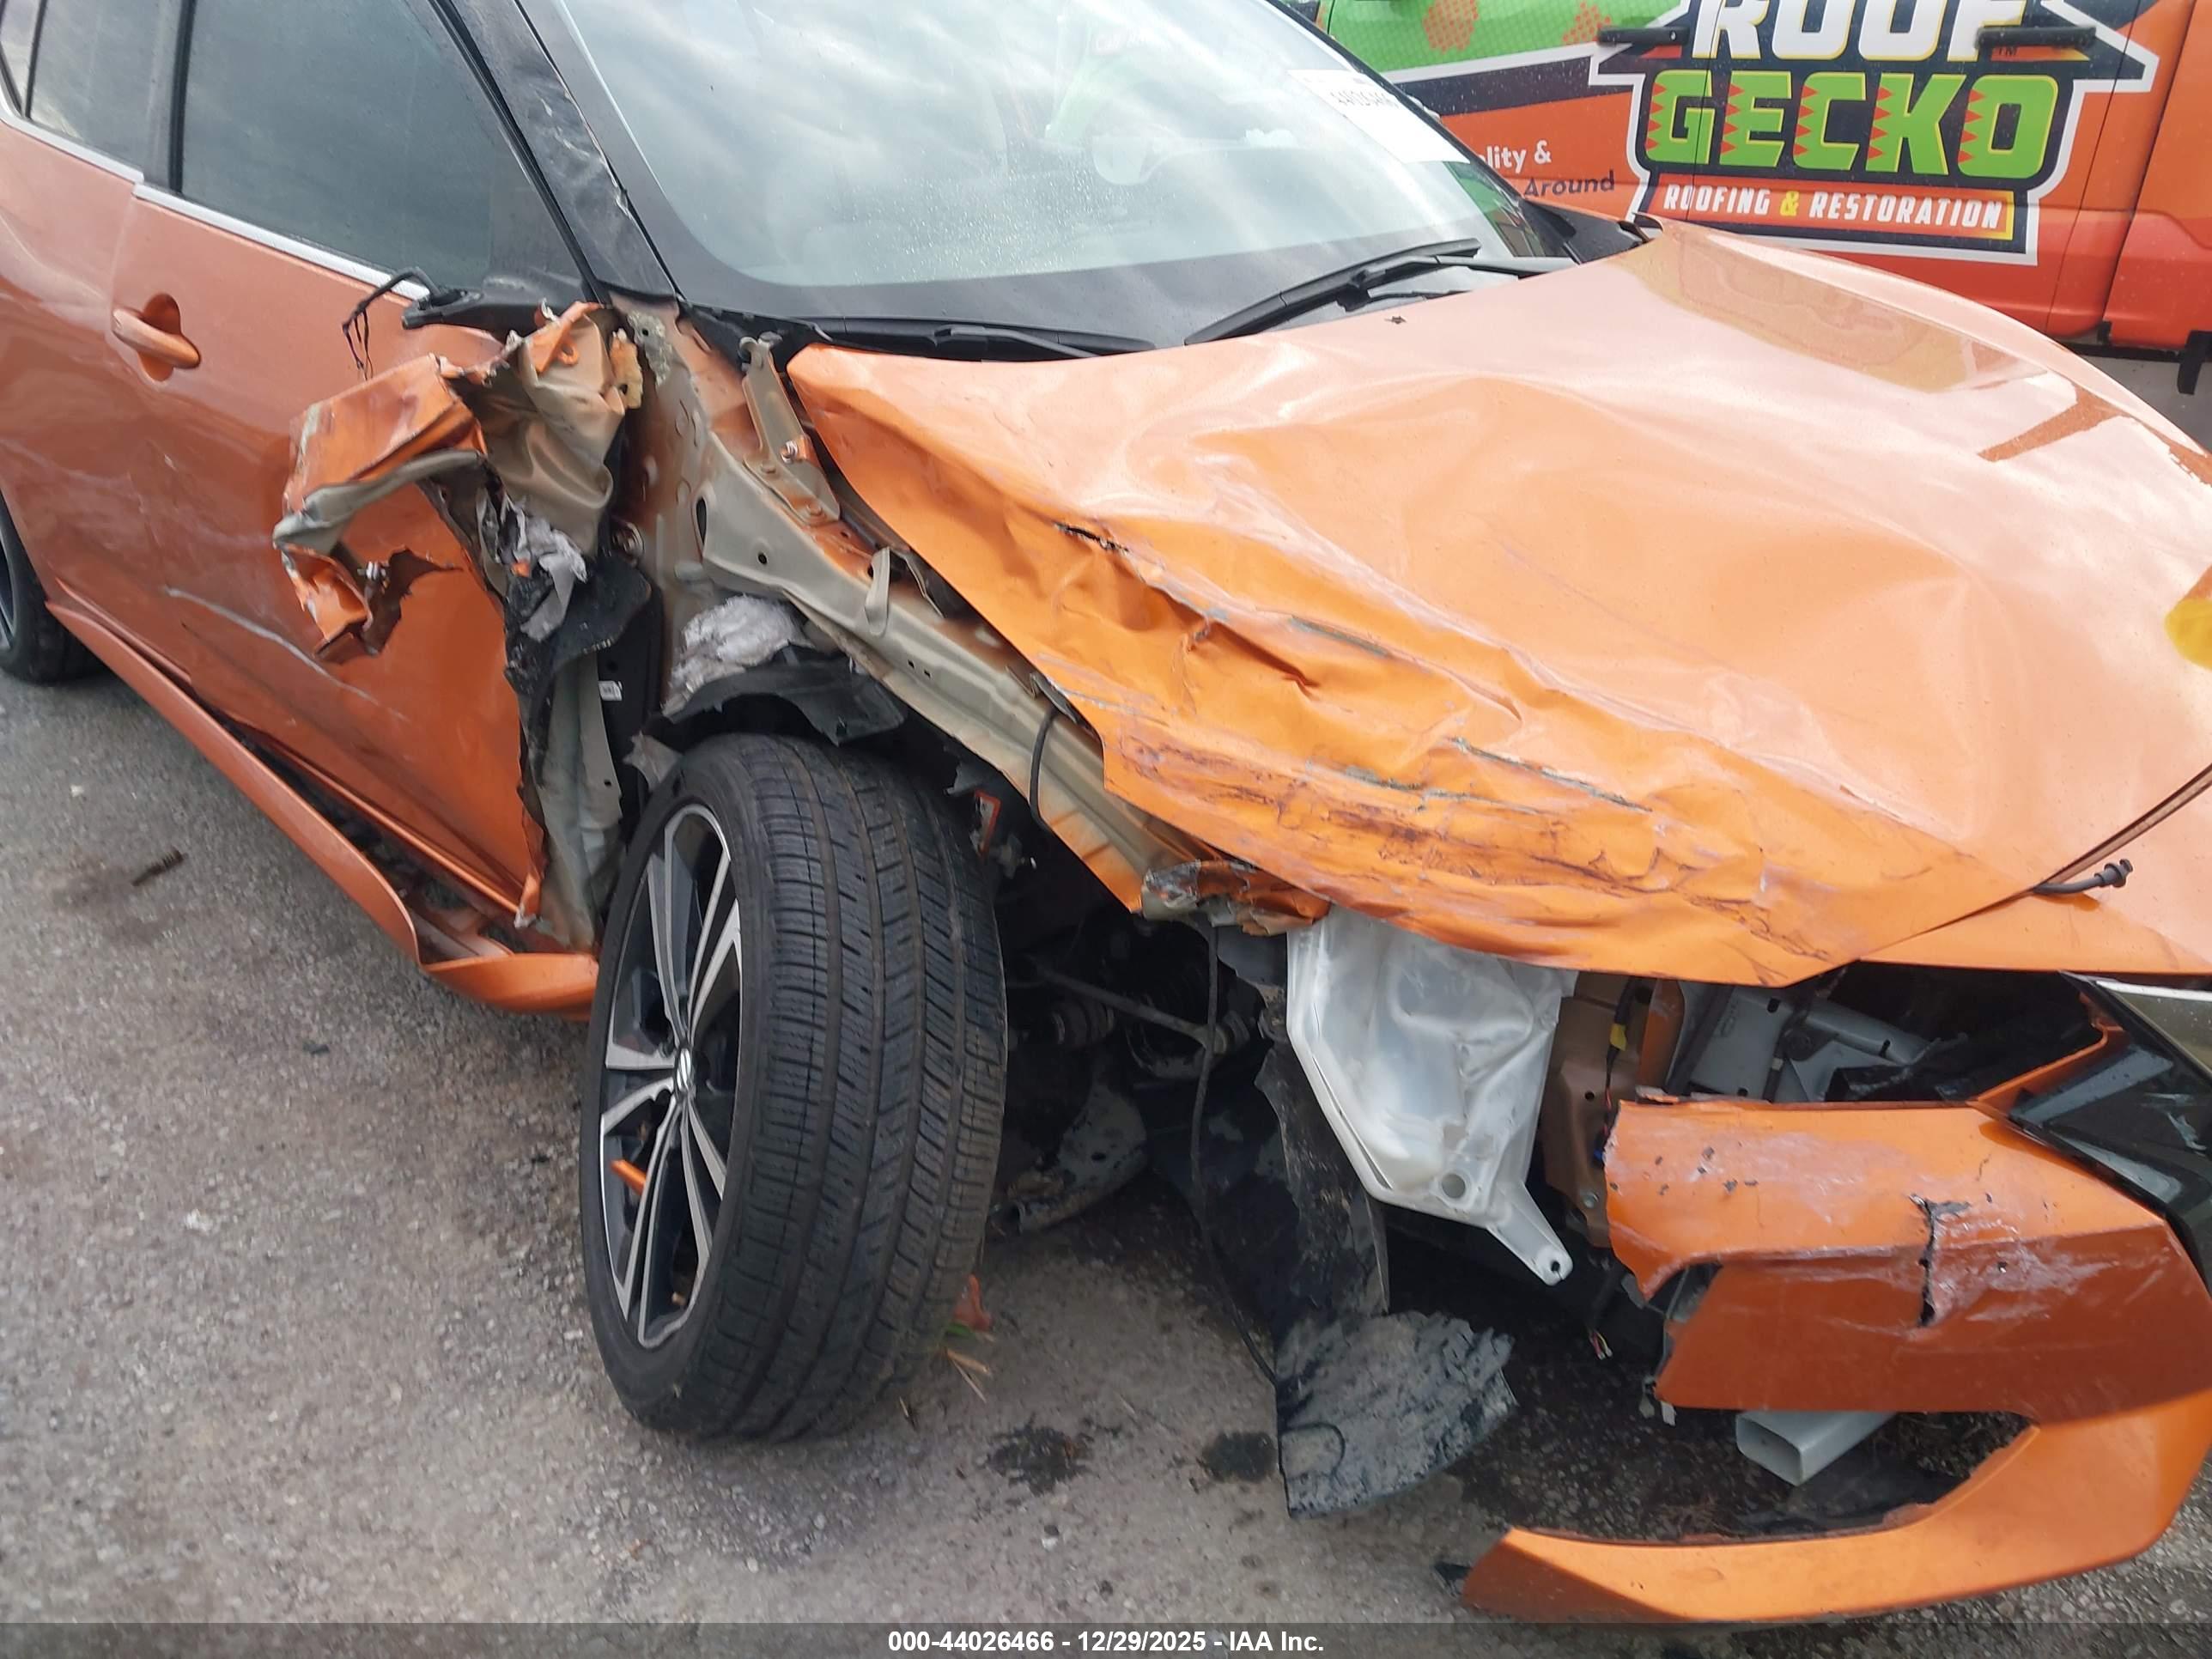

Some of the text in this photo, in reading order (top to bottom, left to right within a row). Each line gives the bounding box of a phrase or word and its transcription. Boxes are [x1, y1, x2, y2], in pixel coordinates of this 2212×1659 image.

[1644, 69, 2059, 179] GECKO
[1533, 139, 1553, 165] &
[1523, 169, 1616, 198] Around
[1663, 182, 2002, 230] ROOFING & RESTORATION
